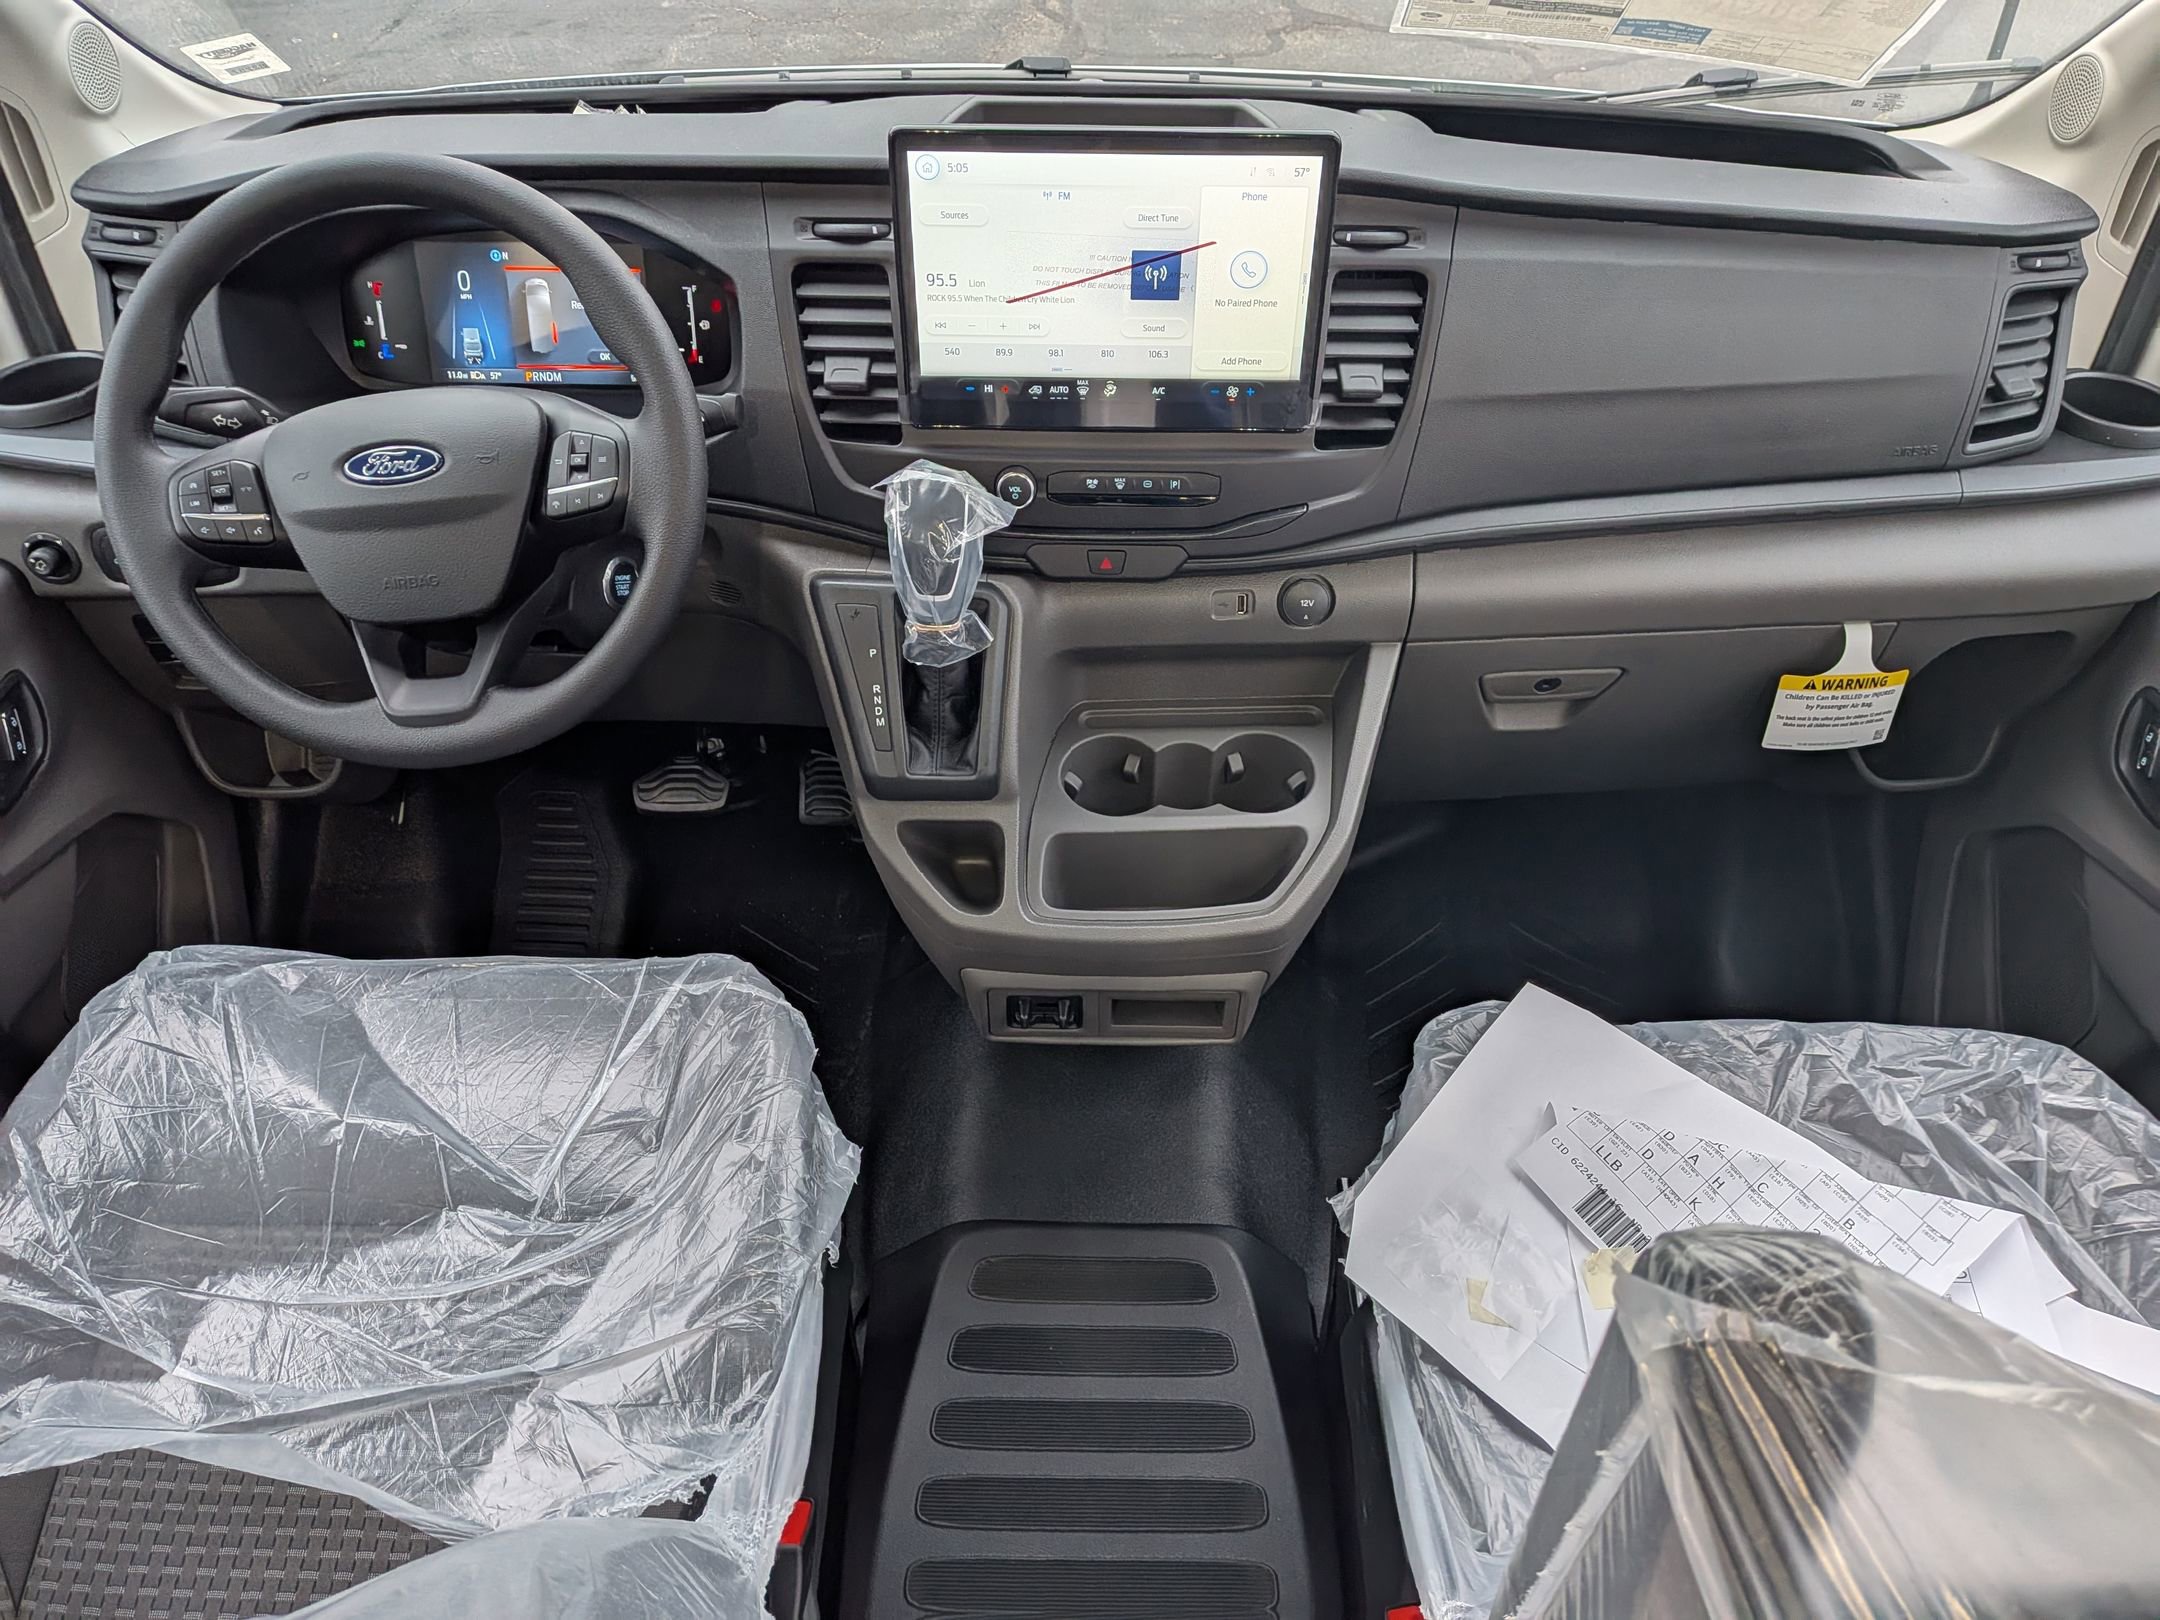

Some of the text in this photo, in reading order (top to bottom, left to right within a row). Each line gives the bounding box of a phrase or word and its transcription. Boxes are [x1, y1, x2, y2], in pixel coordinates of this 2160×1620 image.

[947, 162, 969, 173] 5:05
[1294, 168, 1310, 177] 57°
[1058, 191, 1071, 201] FM
[1242, 192, 1268, 201] Phone
[940, 210, 969, 220] Sources
[1138, 214, 1179, 222] Direct Tune
[502, 252, 509, 260] N
[457, 270, 471, 292] 0
[926, 273, 986, 288] 95.5 Lion
[1097, 282, 1132, 291] REMOVED
[927, 294, 946, 302] ROCK
[947, 294, 963, 302] 95.5
[963, 295, 984, 303] When
[985, 294, 998, 303] The
[1027, 296, 1038, 304] Cry
[1039, 296, 1060, 304] White
[1060, 296, 1075, 304] Lion
[1215, 299, 1278, 308] No Paired Phone
[1142, 324, 1166, 332] Sound
[600, 353, 611, 361] OK
[944, 347, 1169, 359] 540 89.9 98.1 810 106.3
[1221, 357, 1262, 366] Add Phone
[984, 385, 993, 393] HI
[1049, 386, 1069, 394] AUTO
[1151, 386, 1166, 395] A/C
[362, 450, 421, 476] Ford
[381, 575, 439, 591] AIRBAG
[1300, 600, 1315, 608] 12V
[869, 649, 877, 658] P
[1821, 676, 1888, 690] WARNING
[872, 685, 881, 694] R
[1785, 693, 1815, 701] Children
[1871, 689, 1896, 698] INJURED
[873, 696, 882, 705] N
[875, 707, 883, 715] D
[876, 717, 885, 727] M
[1663, 1130, 1675, 1142] D
[1595, 1144, 1623, 1172] LLB
[1642, 1148, 1654, 1160] D
[1687, 1152, 1701, 1165] A
[1550, 1136, 1569, 1155] CID
[1569, 1156, 1608, 1194] 6224244
[1712, 1176, 1725, 1189] H
[1756, 1181, 1768, 1193] C
[1688, 1197, 1702, 1210] K
[1843, 1218, 1855, 1230] B
